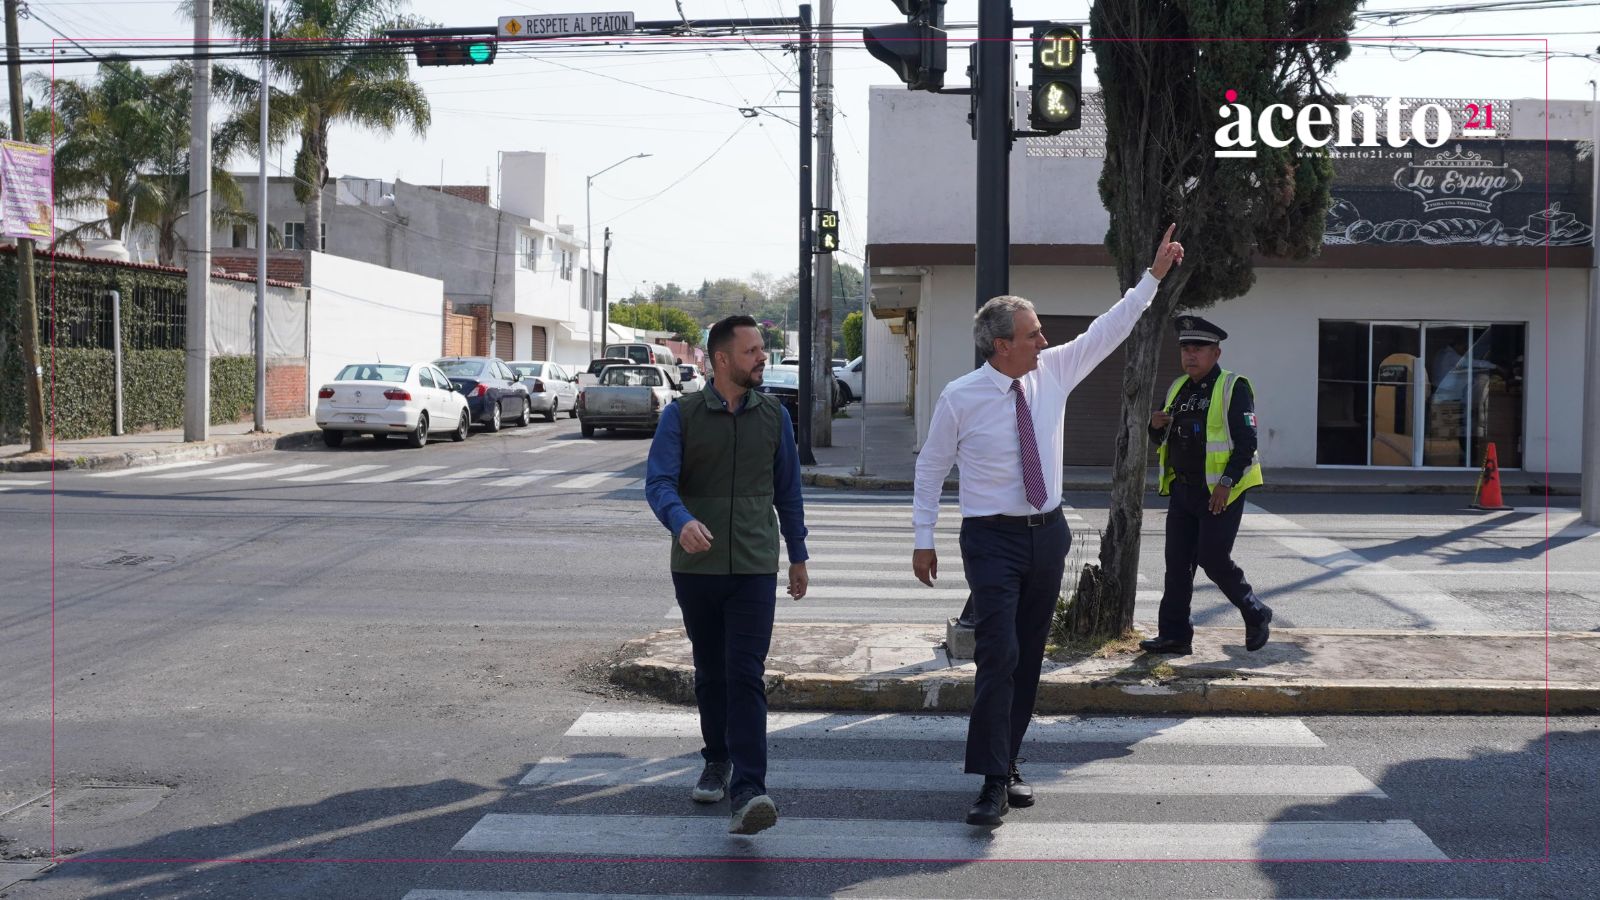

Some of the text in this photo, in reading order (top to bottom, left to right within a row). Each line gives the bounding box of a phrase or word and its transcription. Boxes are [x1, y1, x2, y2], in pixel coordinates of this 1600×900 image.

[526, 15, 628, 34] RESPETE AL PEATON
[1041, 36, 1073, 66] 20
[1408, 169, 1508, 195] La Espiga
[822, 215, 836, 227] 20
